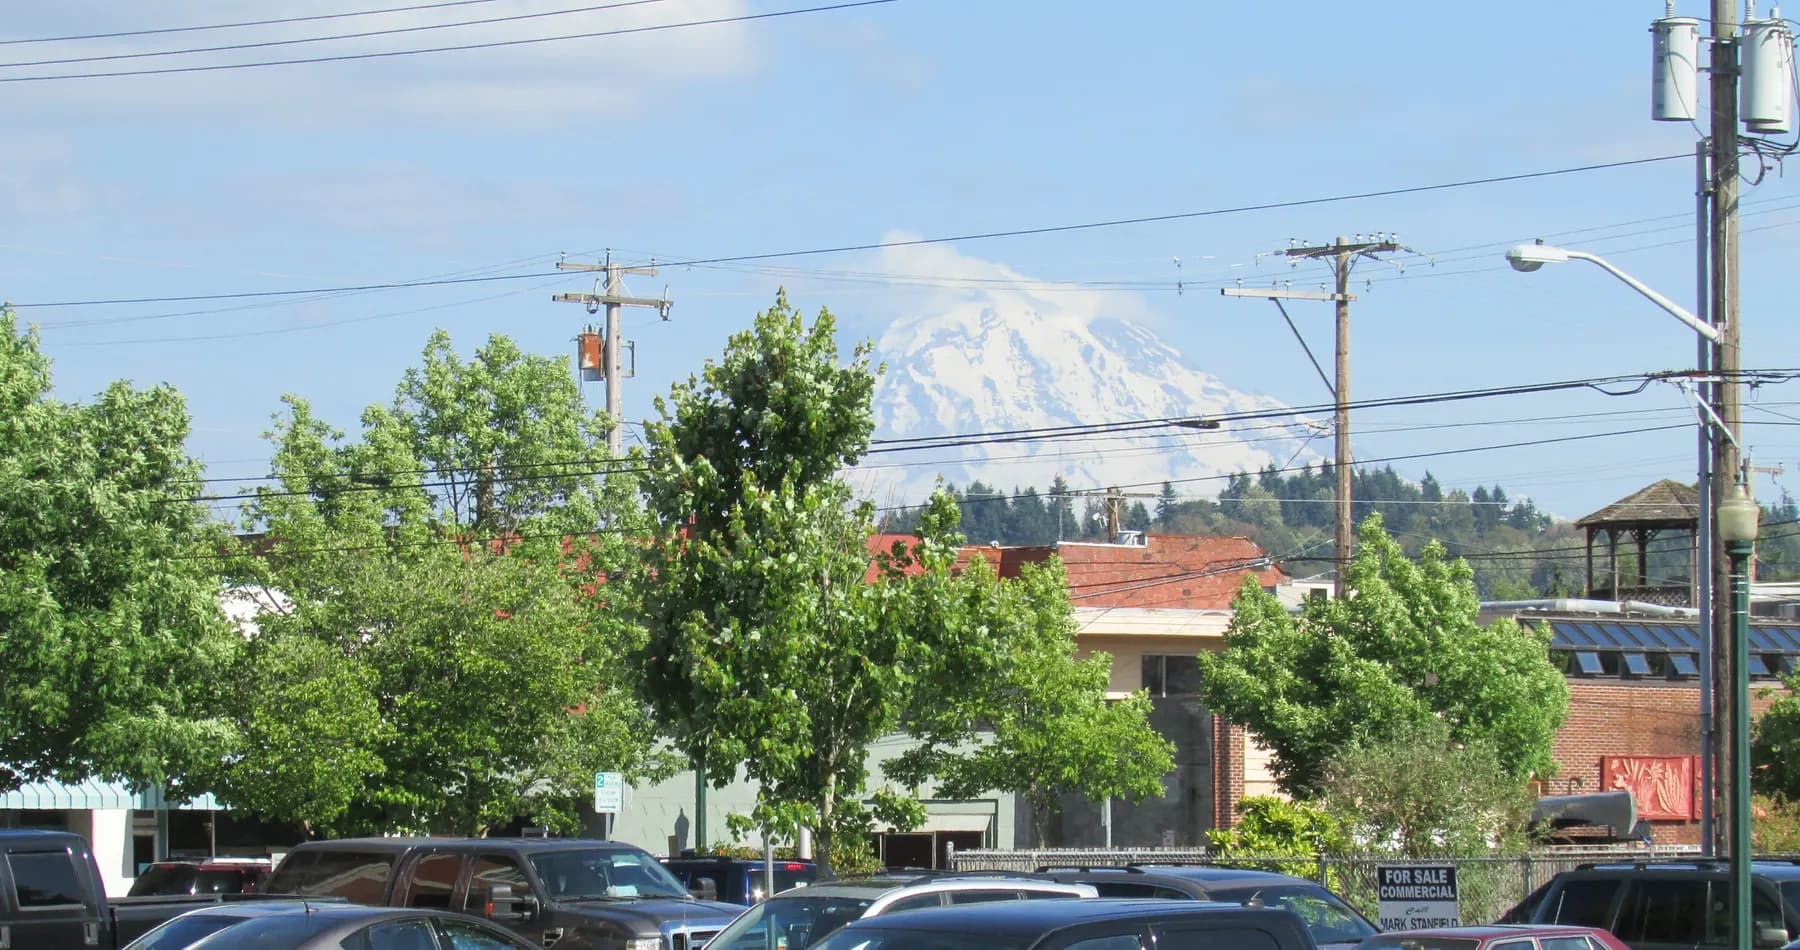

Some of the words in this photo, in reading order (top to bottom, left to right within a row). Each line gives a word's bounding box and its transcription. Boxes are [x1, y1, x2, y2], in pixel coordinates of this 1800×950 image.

[597, 775, 604, 786] 2
[1385, 869, 1411, 884] FOR
[1414, 869, 1448, 884] SALE
[1380, 885, 1455, 898] COMMERCIAL
[1406, 906, 1429, 915] Call
[1381, 917, 1407, 930] MARK
[1410, 917, 1458, 929] STANFIELD
